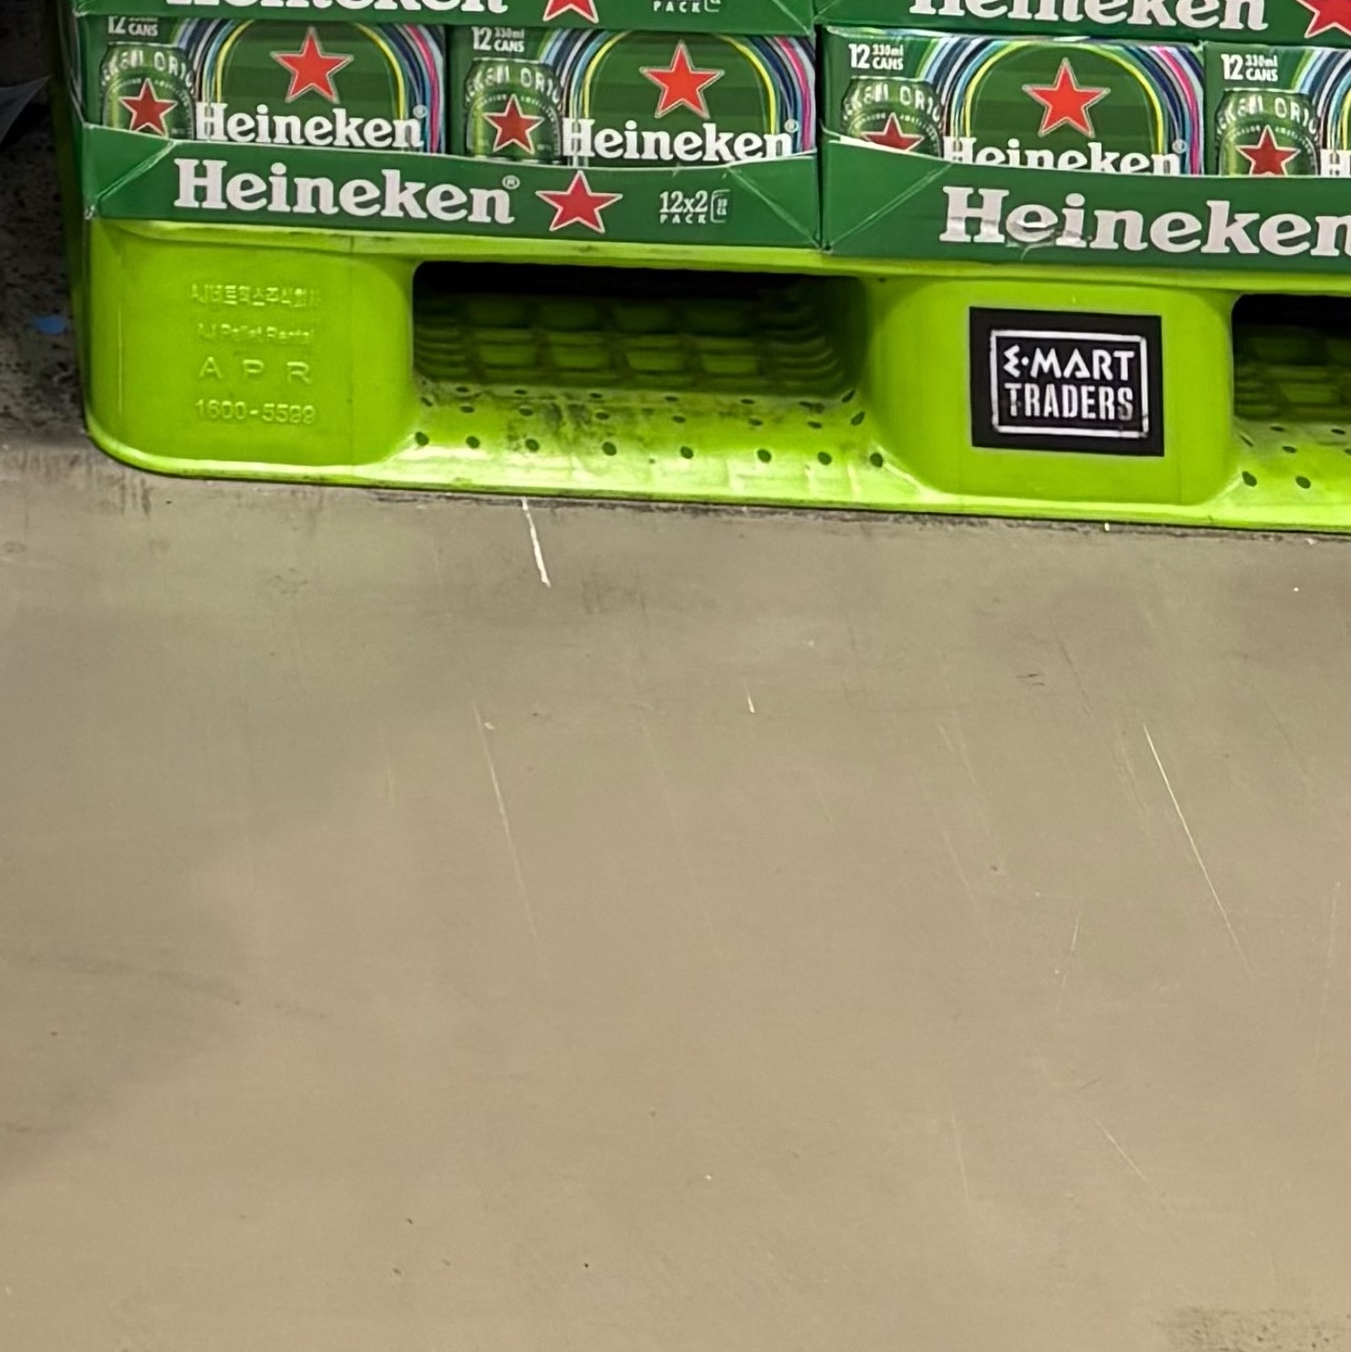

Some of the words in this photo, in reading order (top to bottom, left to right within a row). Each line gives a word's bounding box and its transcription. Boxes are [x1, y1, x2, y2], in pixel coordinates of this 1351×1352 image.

[472, 27, 492, 51] 12
[494, 28, 525, 39] 330ml
[494, 40, 525, 53] CANS
[195, 102, 425, 148] Heineken
[562, 118, 793, 163] Heineken
[174, 158, 515, 223] Heineken
[659, 191, 709, 215] 12x2
[1004, 382, 1134, 421] TRADERS
